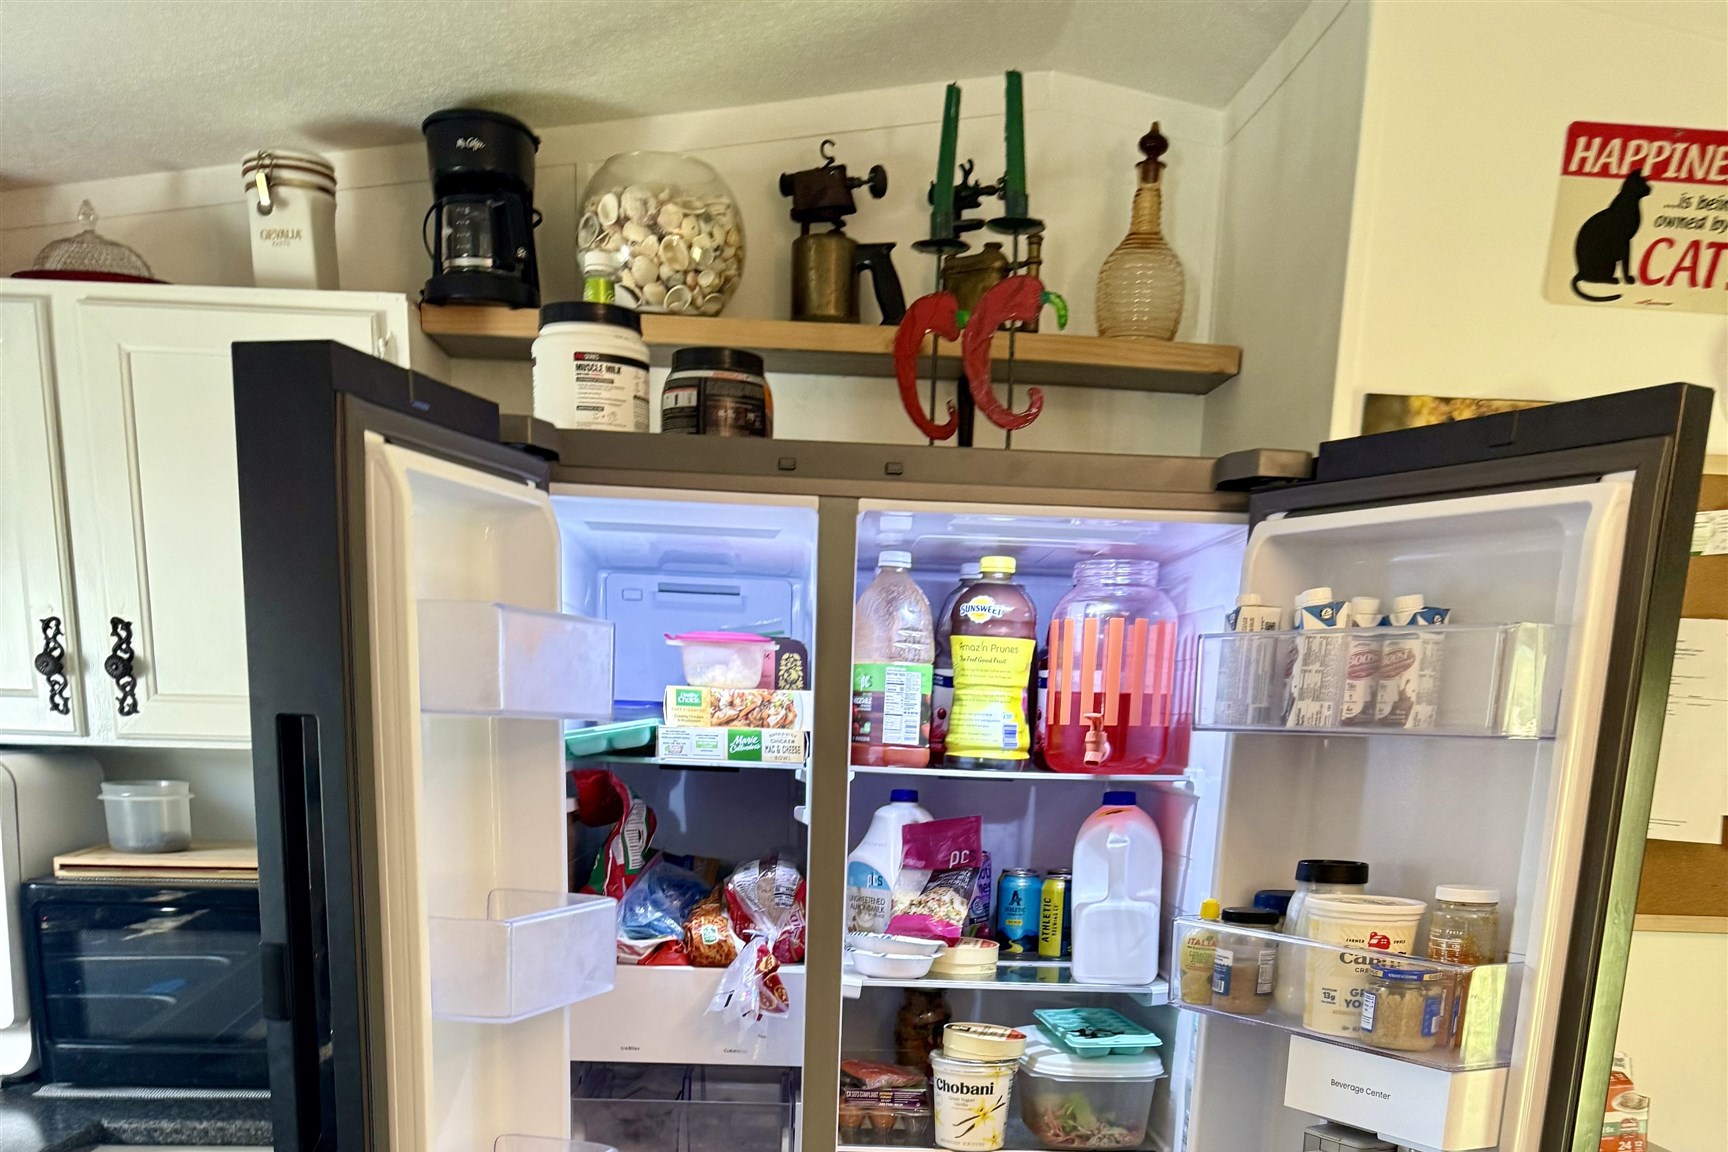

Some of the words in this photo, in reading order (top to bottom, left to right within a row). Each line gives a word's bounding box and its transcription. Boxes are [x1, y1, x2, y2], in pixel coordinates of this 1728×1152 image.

[1654, 215, 1709, 230] owned
[1639, 237, 1728, 290] CAT
[575, 362, 603, 373] MUSCLE
[990, 644, 1019, 654] Prunes
[1041, 897, 1052, 943] ATHLETIC
[1322, 991, 1336, 1001] 13g
[936, 1077, 994, 1096] Chobani
[1330, 1078, 1364, 1095] Beverage
[1365, 1087, 1391, 1100] Center
[1618, 1140, 1632, 1151] 24
